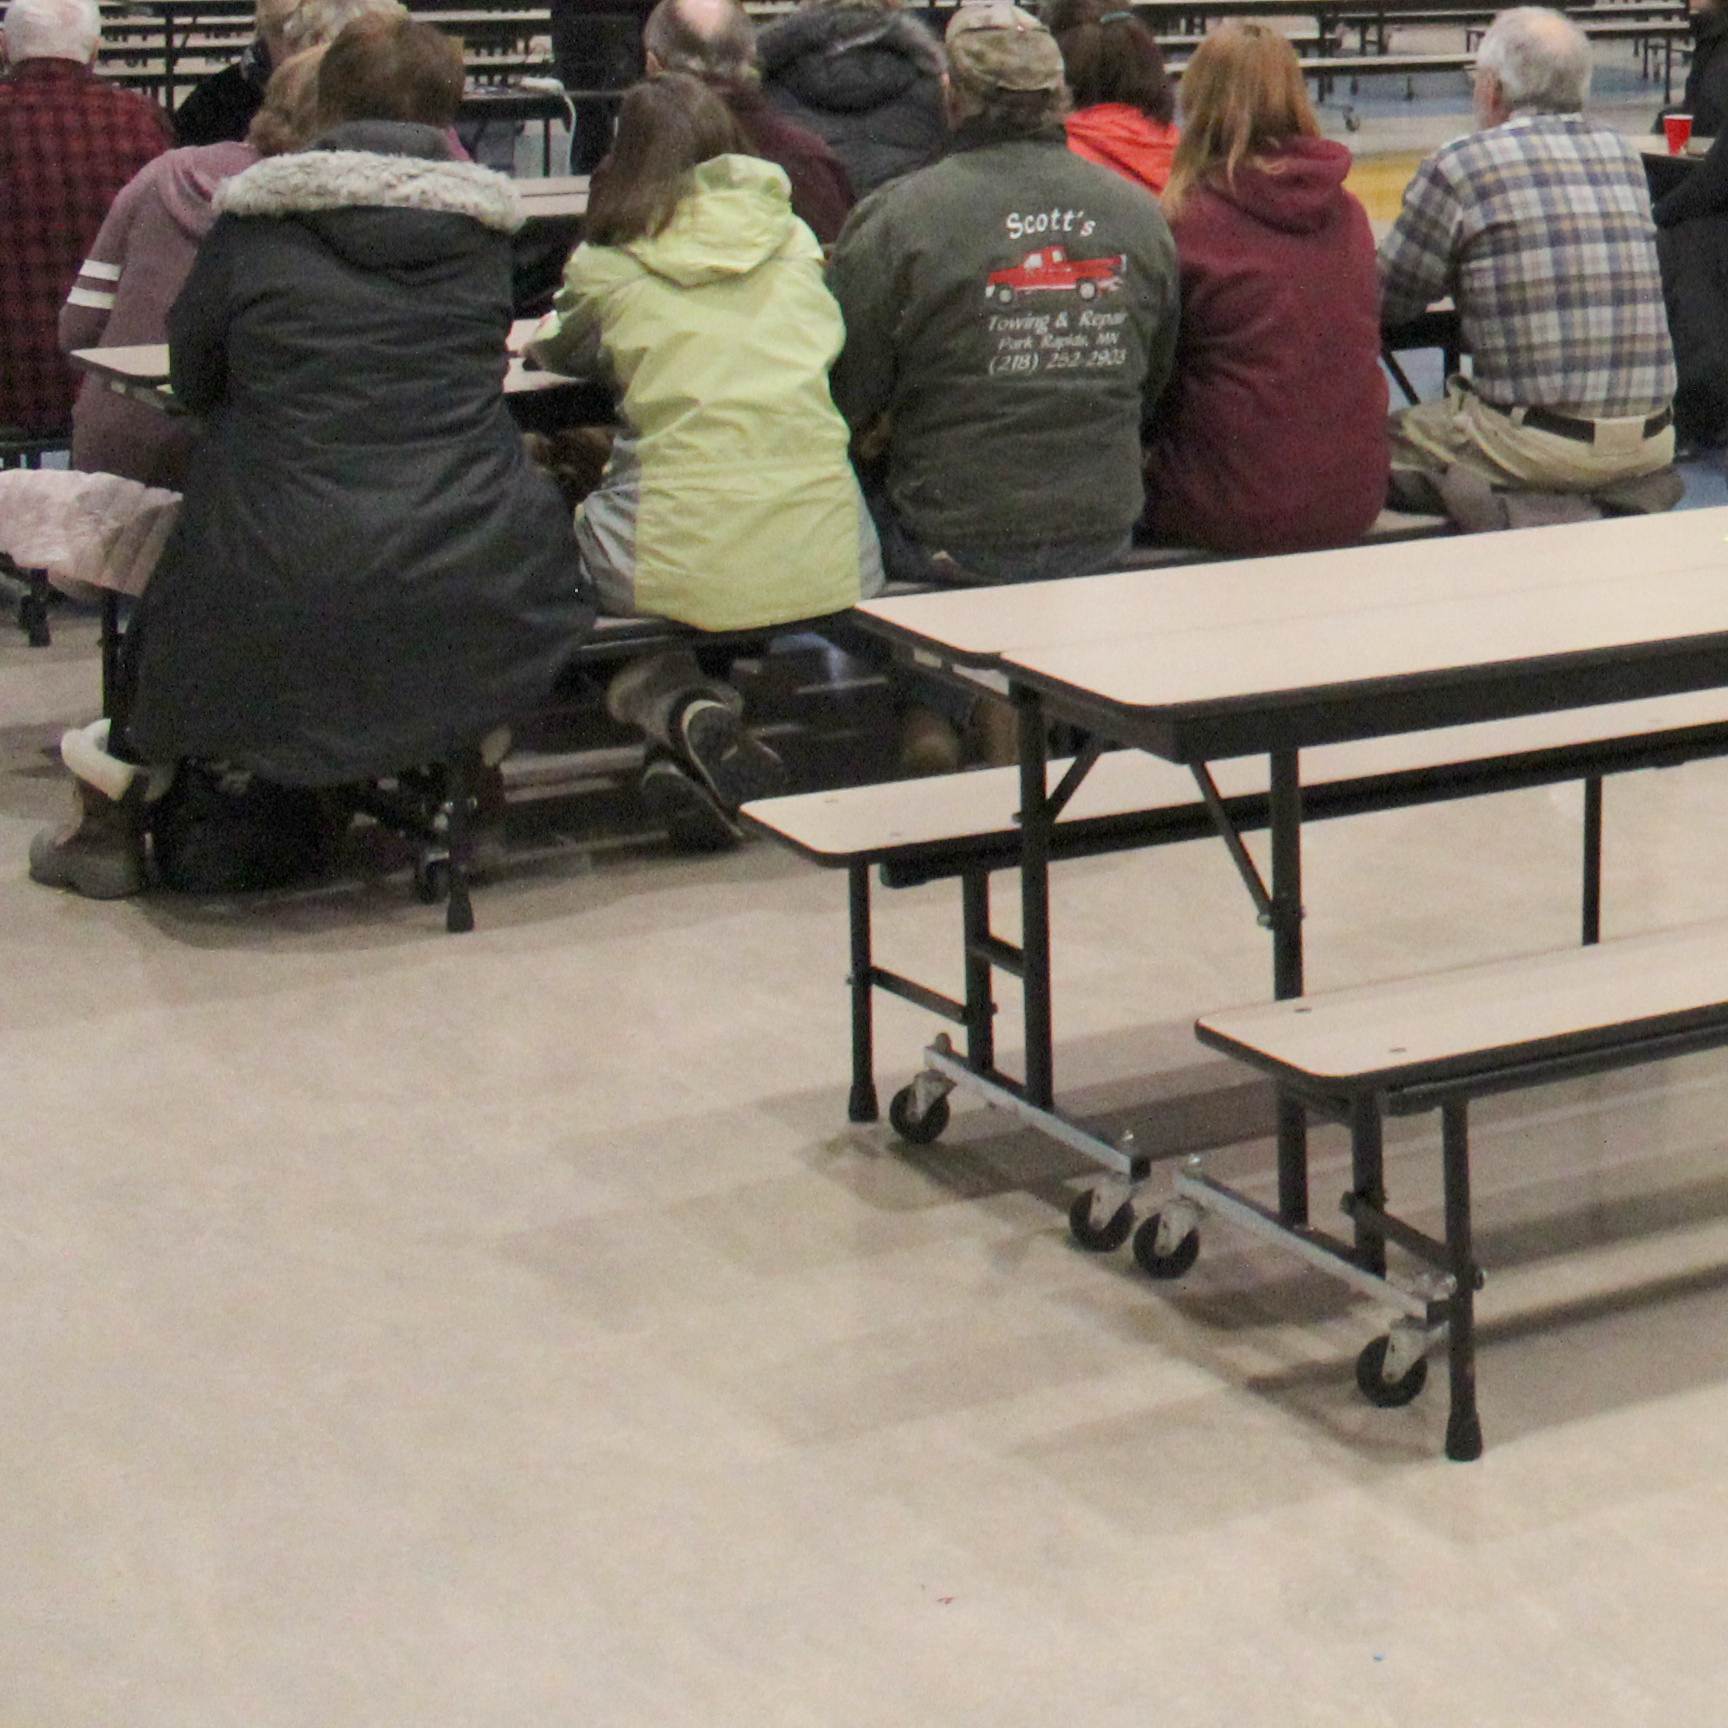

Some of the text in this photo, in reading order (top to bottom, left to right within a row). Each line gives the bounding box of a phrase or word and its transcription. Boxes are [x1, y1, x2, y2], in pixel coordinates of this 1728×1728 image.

[1006, 208, 1096, 239] Scott's
[988, 309, 1128, 334] Towing & Repair
[998, 336, 1034, 351] Park
[988, 352, 1039, 375] (218)
